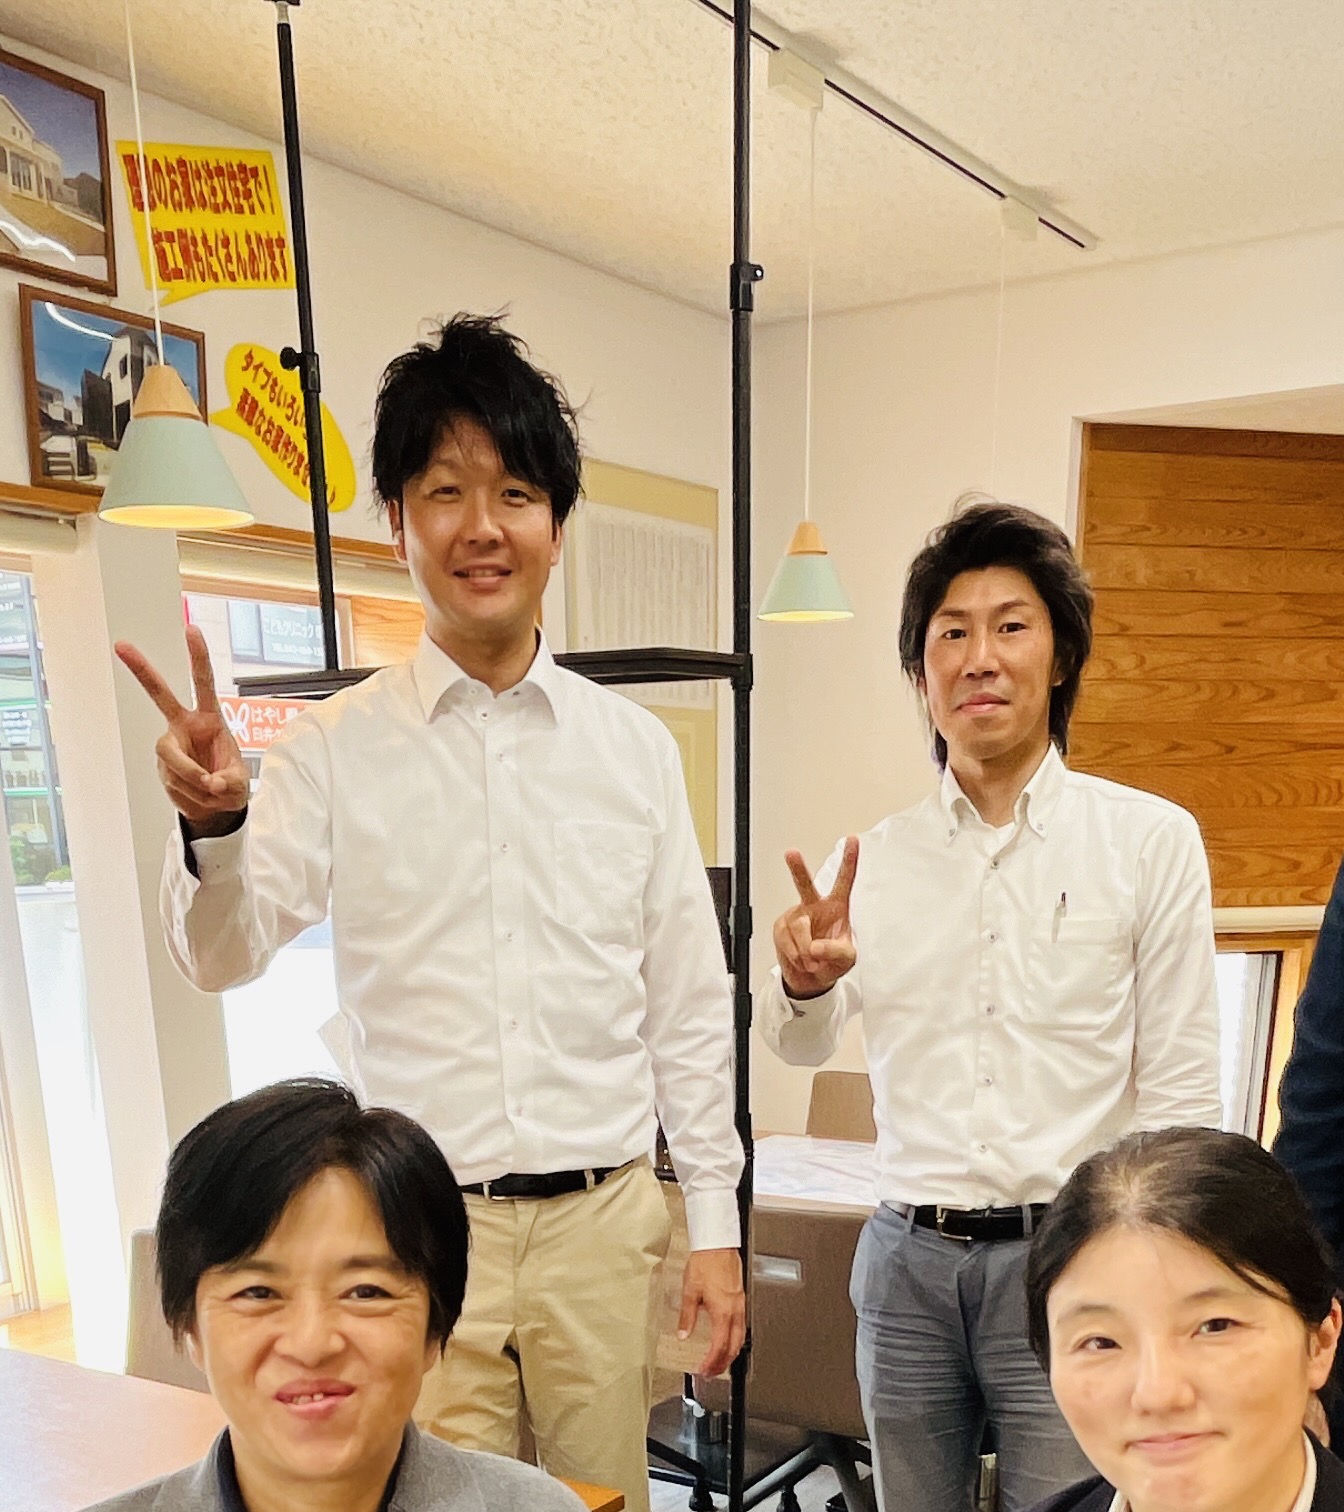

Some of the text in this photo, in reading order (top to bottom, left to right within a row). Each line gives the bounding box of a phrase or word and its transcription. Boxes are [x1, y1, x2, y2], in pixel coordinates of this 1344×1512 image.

[242, 348, 309, 441] タイプもいろい
